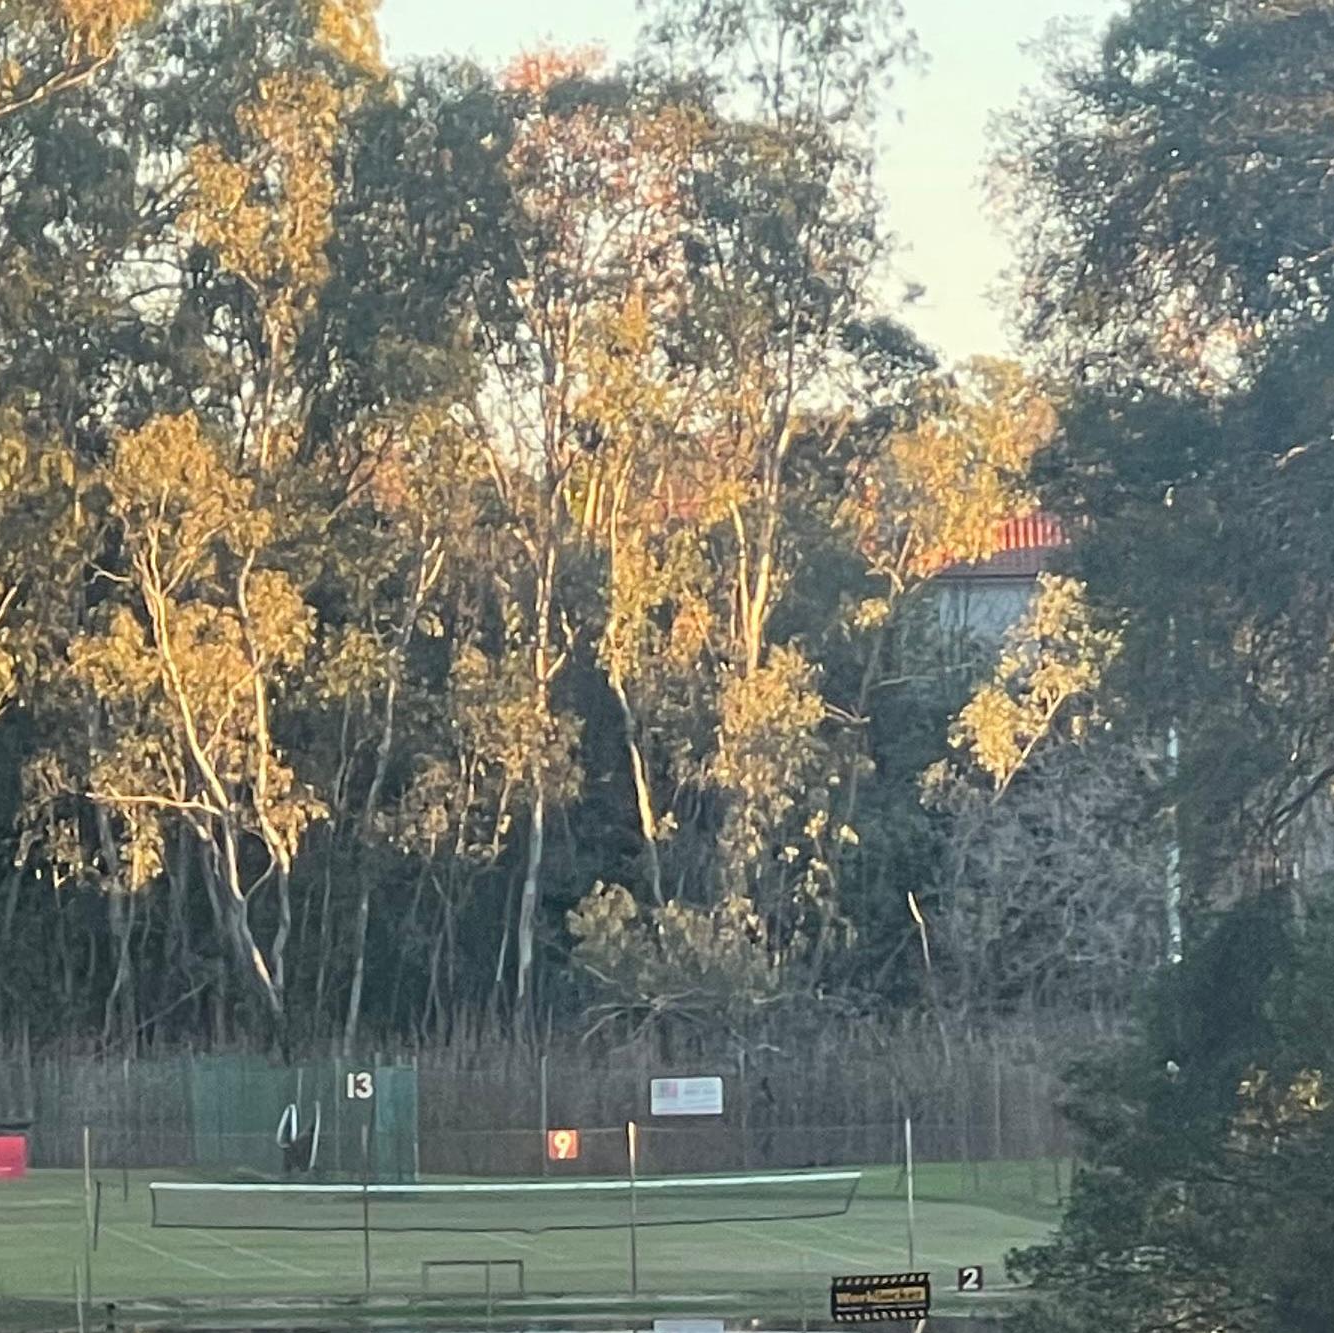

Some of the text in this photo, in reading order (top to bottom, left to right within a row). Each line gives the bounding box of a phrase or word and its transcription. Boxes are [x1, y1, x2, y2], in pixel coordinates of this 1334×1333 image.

[347, 1072, 374, 1099] 13
[553, 1131, 572, 1159] 9
[962, 1267, 979, 1289] 2
